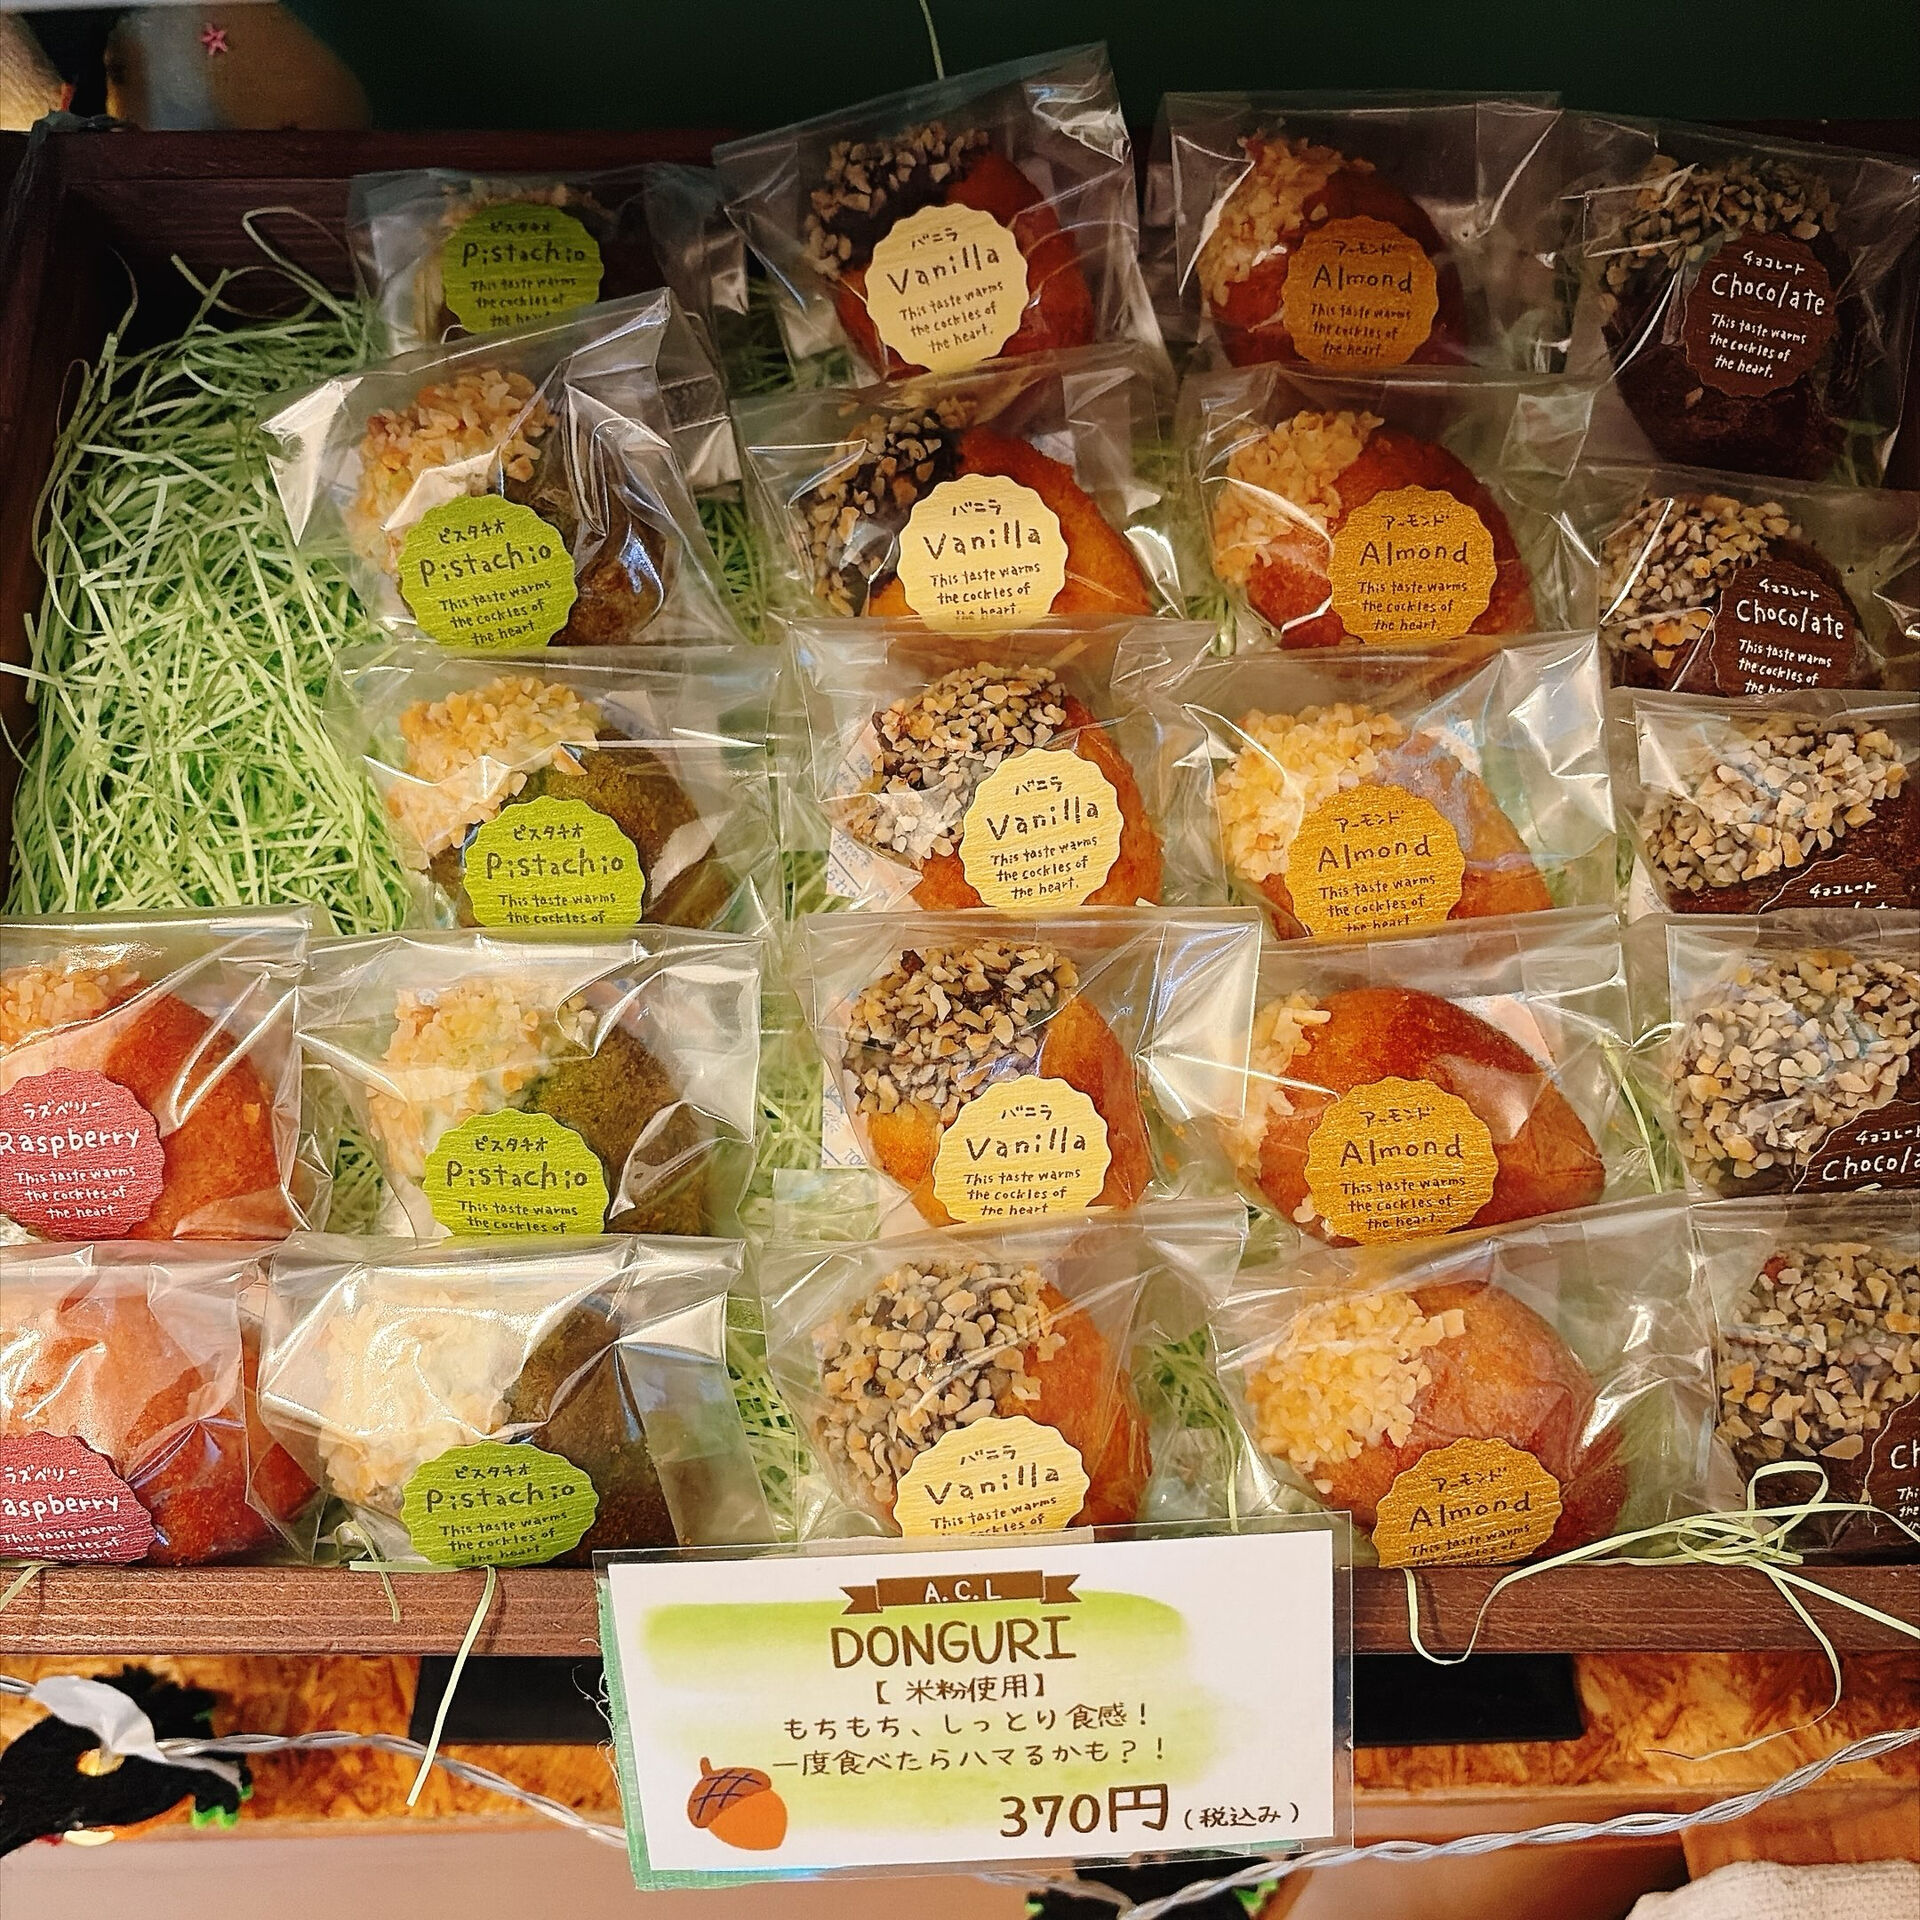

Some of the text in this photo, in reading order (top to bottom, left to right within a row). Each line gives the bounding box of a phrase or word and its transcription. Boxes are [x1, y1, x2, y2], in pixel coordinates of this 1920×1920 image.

[911, 227, 958, 250] バニラ
[461, 241, 585, 268] Pistachio
[887, 243, 1000, 295] Vanilla
[1312, 264, 1412, 293] Almond
[899, 281, 1003, 321] This taste warms
[1711, 272, 1825, 315] Chocolate
[911, 301, 997, 337] the cockles of
[1711, 313, 1807, 345] This taste warms
[929, 338, 950, 353] the
[1709, 332, 1792, 362] the cockles of
[1714, 354, 1734, 370] the
[952, 499, 1002, 516] バニラ
[438, 518, 506, 544] ピスタチオ
[1381, 514, 1450, 530] アーモンド
[923, 520, 1041, 560] Vanilla
[419, 542, 552, 588] Pistachio
[1359, 541, 1469, 566] Almond
[930, 563, 1041, 587] This taste warms
[439, 580, 552, 613] This taste warms
[937, 582, 1031, 605] the cockles of
[1358, 581, 1468, 594] This taste warms
[450, 598, 545, 629] the cockles of
[1362, 599, 1454, 613] the cockles of
[1373, 619, 1395, 631] the
[1736, 599, 1845, 640] Chocolate
[471, 631, 495, 646] the
[1739, 639, 1832, 668] This taste warms
[1738, 658, 1820, 686] the cockles of
[1015, 776, 1063, 795] バニラ
[986, 796, 1099, 840] Vanilla
[1333, 810, 1405, 833] アーモンド
[513, 823, 585, 841] ピスタチオ
[991, 836, 1098, 866] This taste warms
[1317, 834, 1432, 872] Almond
[486, 848, 624, 879] Pistachio
[996, 856, 1089, 882] the cockles of
[1011, 886, 1033, 899] the
[1319, 875, 1436, 900] This taste warms
[499, 893, 616, 908] This taste warms
[1327, 894, 1426, 917] the cockles of
[506, 910, 606, 924] the cockles of
[23, 1100, 102, 1120] ラズベリー
[1001, 1104, 1053, 1120] バニラ
[1359, 1106, 1435, 1127] アーモンド
[0, 1128, 140, 1159] Raspberry
[474, 1135, 549, 1152] ピスタチオ
[966, 1126, 1086, 1161] Vanilla
[1340, 1133, 1464, 1167] Almond
[14, 1166, 136, 1185] This taste warms
[446, 1160, 588, 1189] Pistachio
[964, 1169, 1081, 1186] This taste warms
[1340, 1177, 1465, 1196] This taste warms
[25, 1186, 127, 1202] the cockles of
[967, 1186, 1067, 1200] the cockles of
[1348, 1195, 1452, 1212] the cockles of
[46, 1207, 70, 1219] the
[458, 1200, 578, 1216] This taste warms
[981, 1205, 1003, 1216] the
[467, 1216, 568, 1234] the cockles of
[1366, 1218, 1389, 1230] the
[960, 1445, 1017, 1466] バニラ
[5, 1465, 78, 1484] ラズベリー
[455, 1464, 531, 1479] ピスタチオ
[1431, 1467, 1506, 1493] アーモンド
[924, 1463, 1060, 1505] Vanilla
[2, 1493, 118, 1523] aspberry
[426, 1482, 576, 1513] Pistachio
[930, 1497, 1057, 1530] This taste warms
[1030, 1514, 1046, 1525] of
[1409, 1491, 1532, 1533] Almond
[37, 1529, 75, 1542] taste
[78, 1524, 125, 1536] warms
[439, 1512, 568, 1537] This taste warms
[448, 1528, 556, 1552] the cockles of
[924, 1579, 1002, 1604] A.C.L
[831, 1615, 1077, 1668] DONGURI
[784, 1702, 1149, 1741] もちもち、しっとり食感！
[772, 1737, 1164, 1776] 一度食べたらハマるかも？！
[1000, 1783, 1169, 1837] 370円
